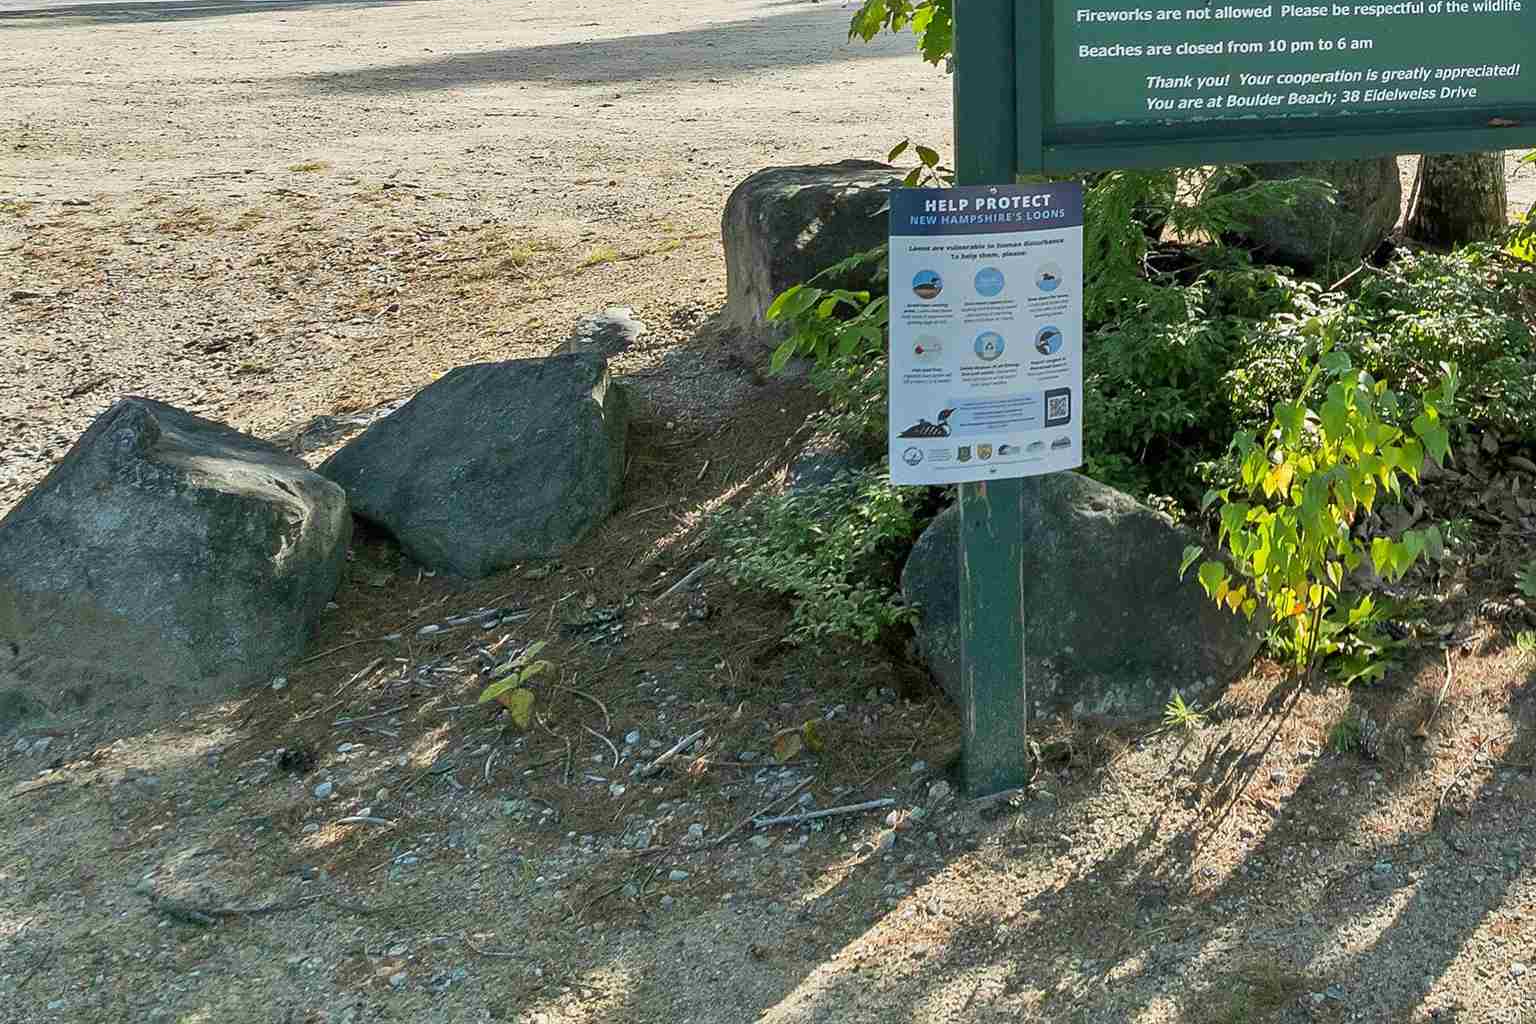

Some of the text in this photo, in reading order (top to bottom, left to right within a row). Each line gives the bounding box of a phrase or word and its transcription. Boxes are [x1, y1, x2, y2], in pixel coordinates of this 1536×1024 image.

[1078, 37, 1372, 57] Beaches are closed from 10 pm to 6 am
[1146, 63, 1520, 89] Thank you! Your cooperation is greatly appreciated!
[1146, 85, 1476, 110] You are at Boulder Beach; 38 Eidelweiss Drive
[925, 194, 1051, 212] HELP PROTECT
[910, 208, 1065, 225] NEW HAMPSHIRE'S LOONS
